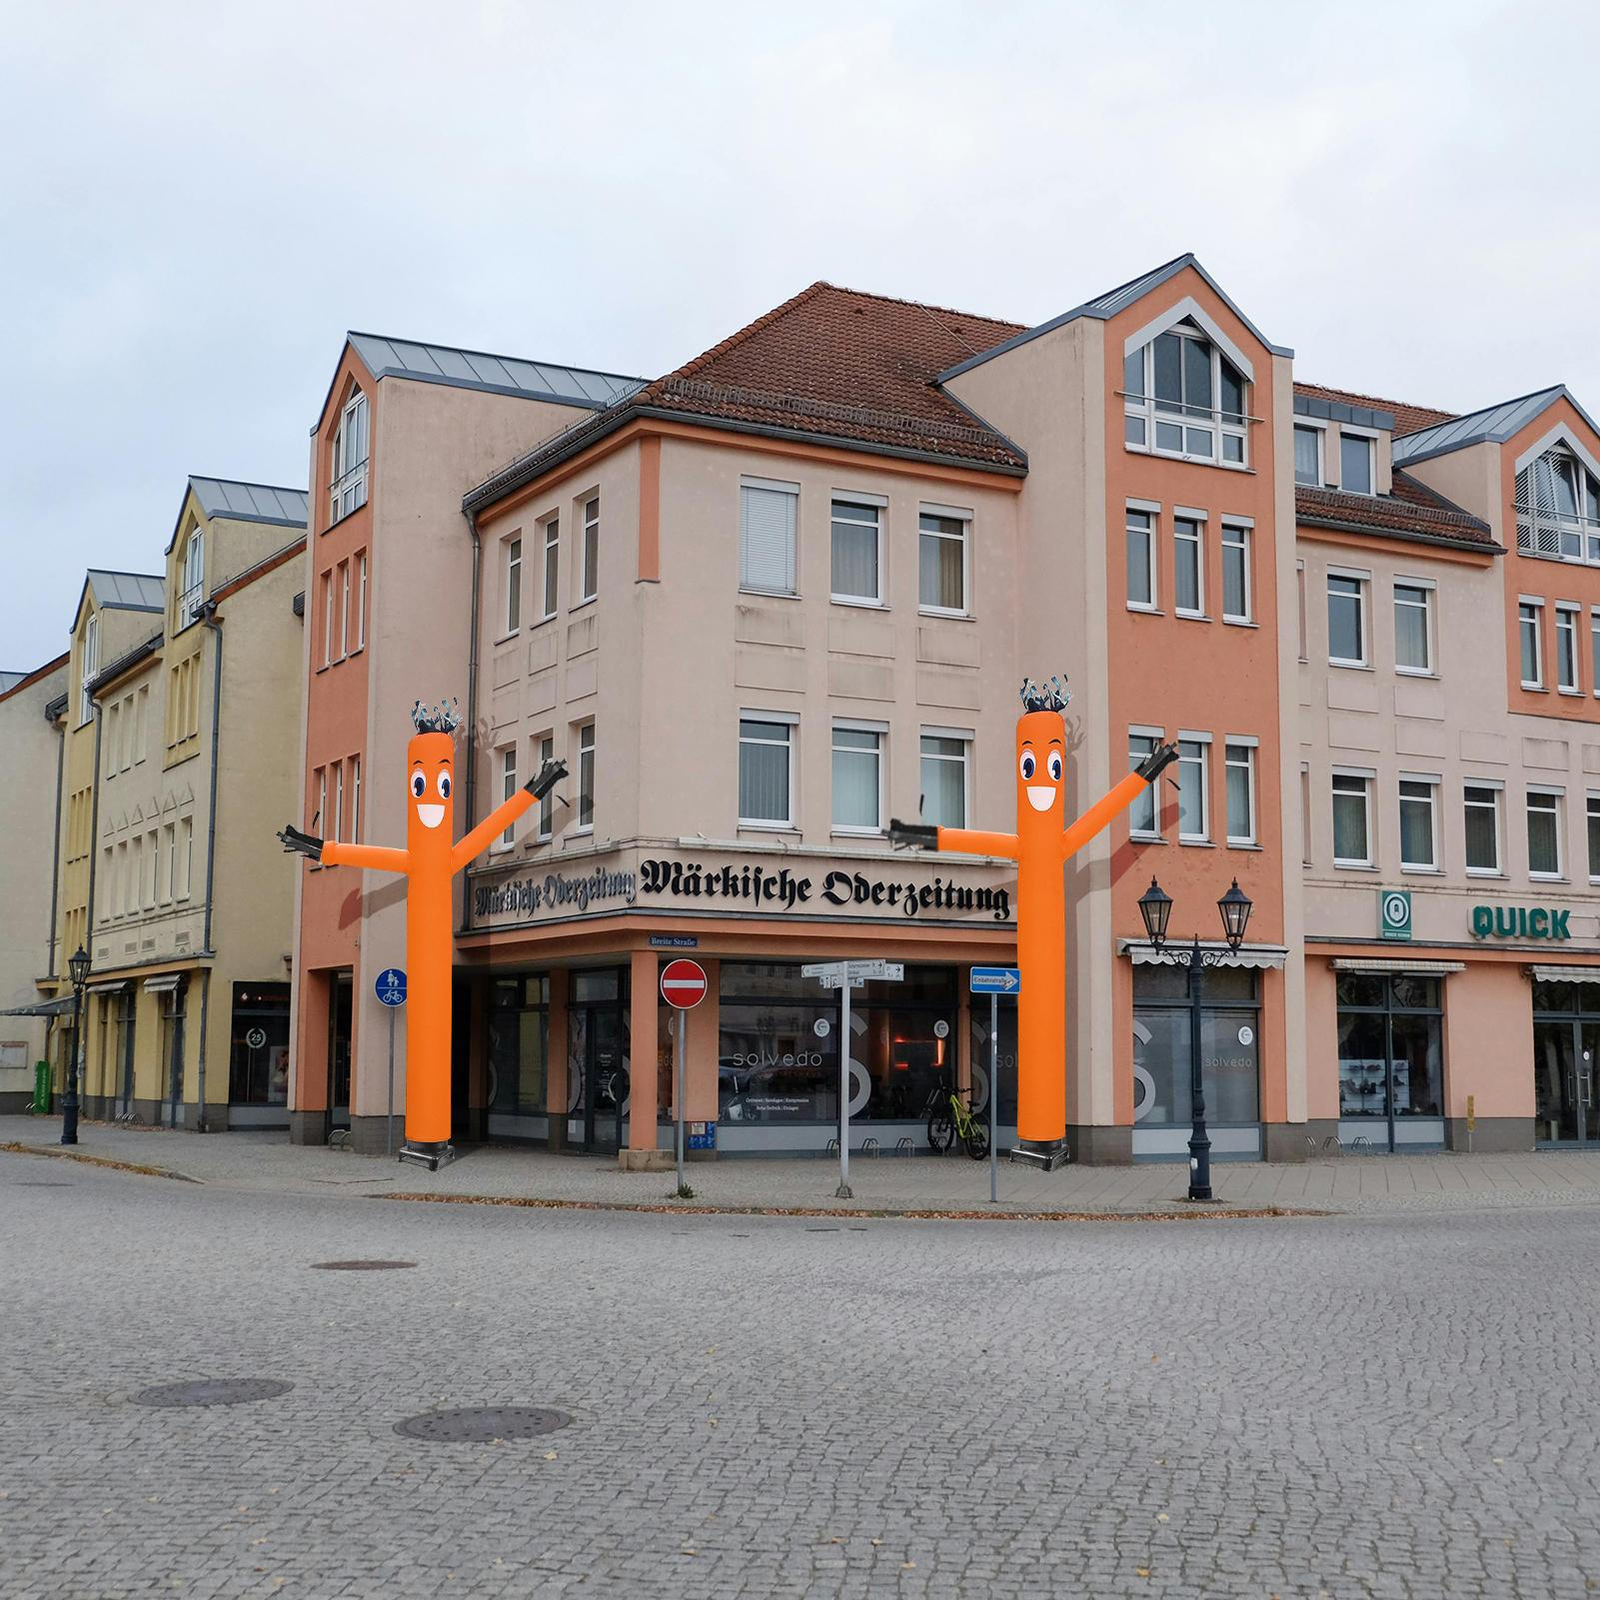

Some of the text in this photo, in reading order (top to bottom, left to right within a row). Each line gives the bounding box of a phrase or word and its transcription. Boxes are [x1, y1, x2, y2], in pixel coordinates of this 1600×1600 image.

[821, 871, 1010, 920] Oderzeitung
[1472, 906, 1571, 939] QUICK
[651, 937, 696, 946] Breite Straße
[251, 1033, 261, 1041] 25
[733, 1050, 822, 1067] solvedo
[1206, 1057, 1251, 1067] solvedo
